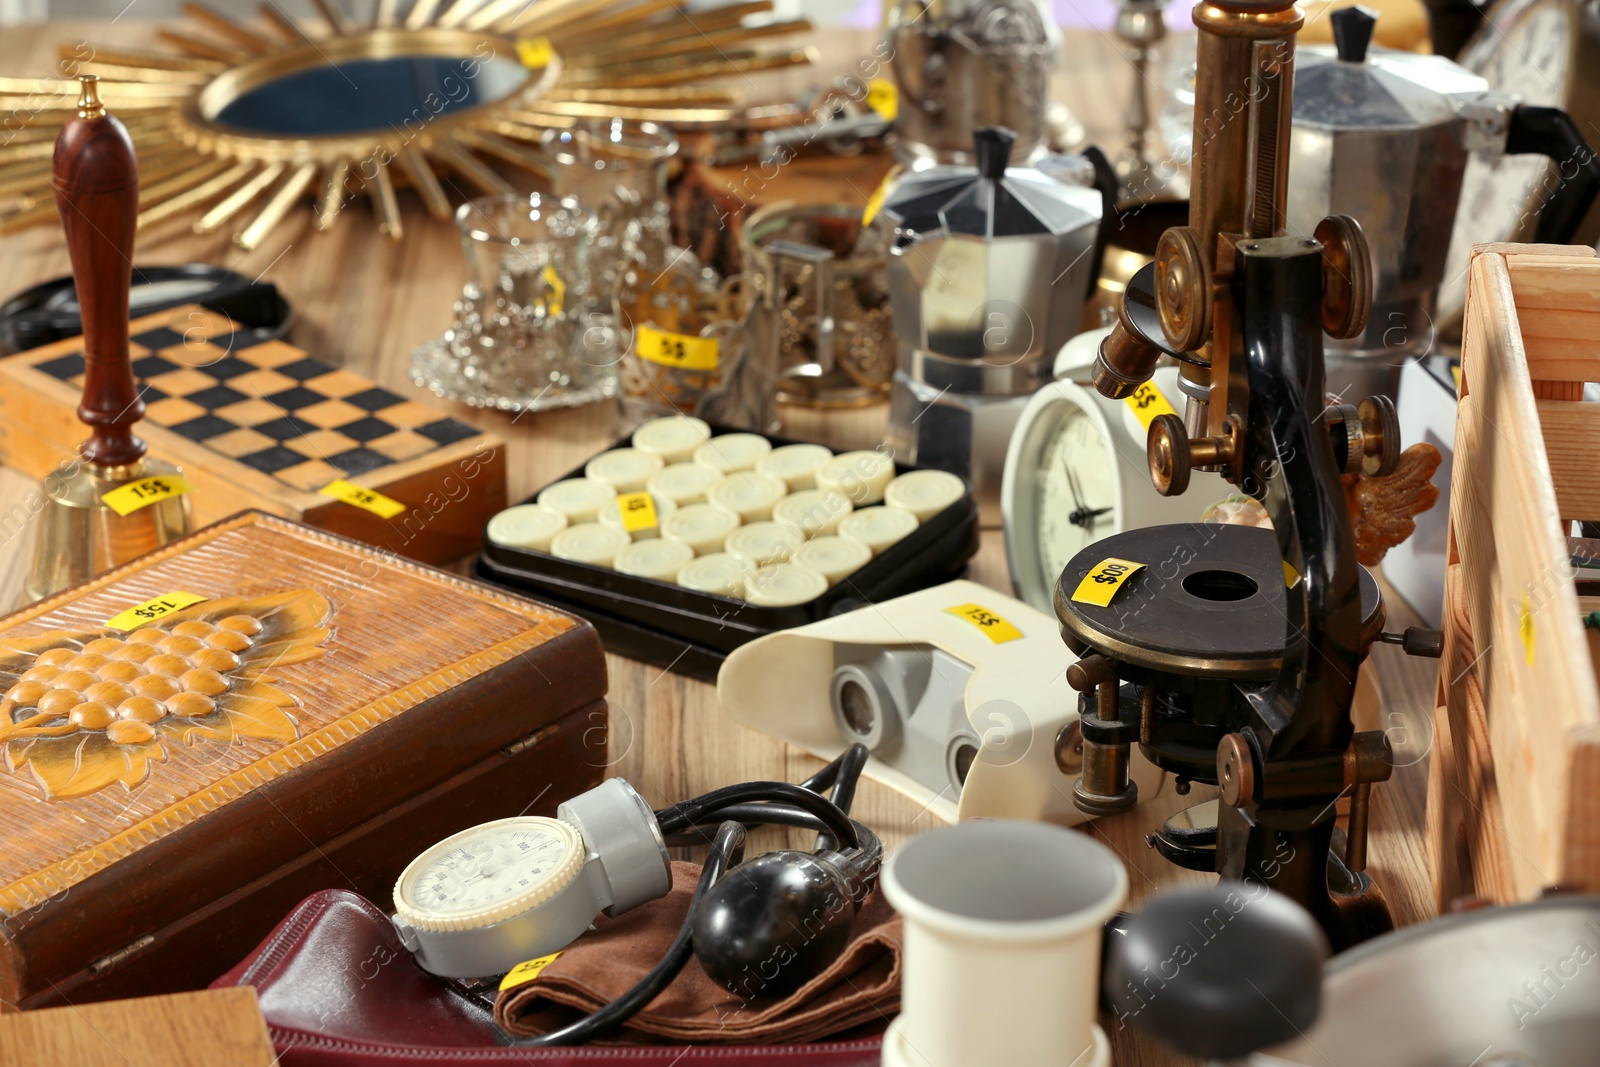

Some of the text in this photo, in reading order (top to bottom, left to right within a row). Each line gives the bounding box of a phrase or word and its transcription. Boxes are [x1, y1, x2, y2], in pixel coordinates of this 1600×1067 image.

[129, 479, 171, 500] 15$
[1091, 563, 1130, 586] 60$
[132, 601, 177, 619] 15$
[966, 608, 1000, 628] 15$
